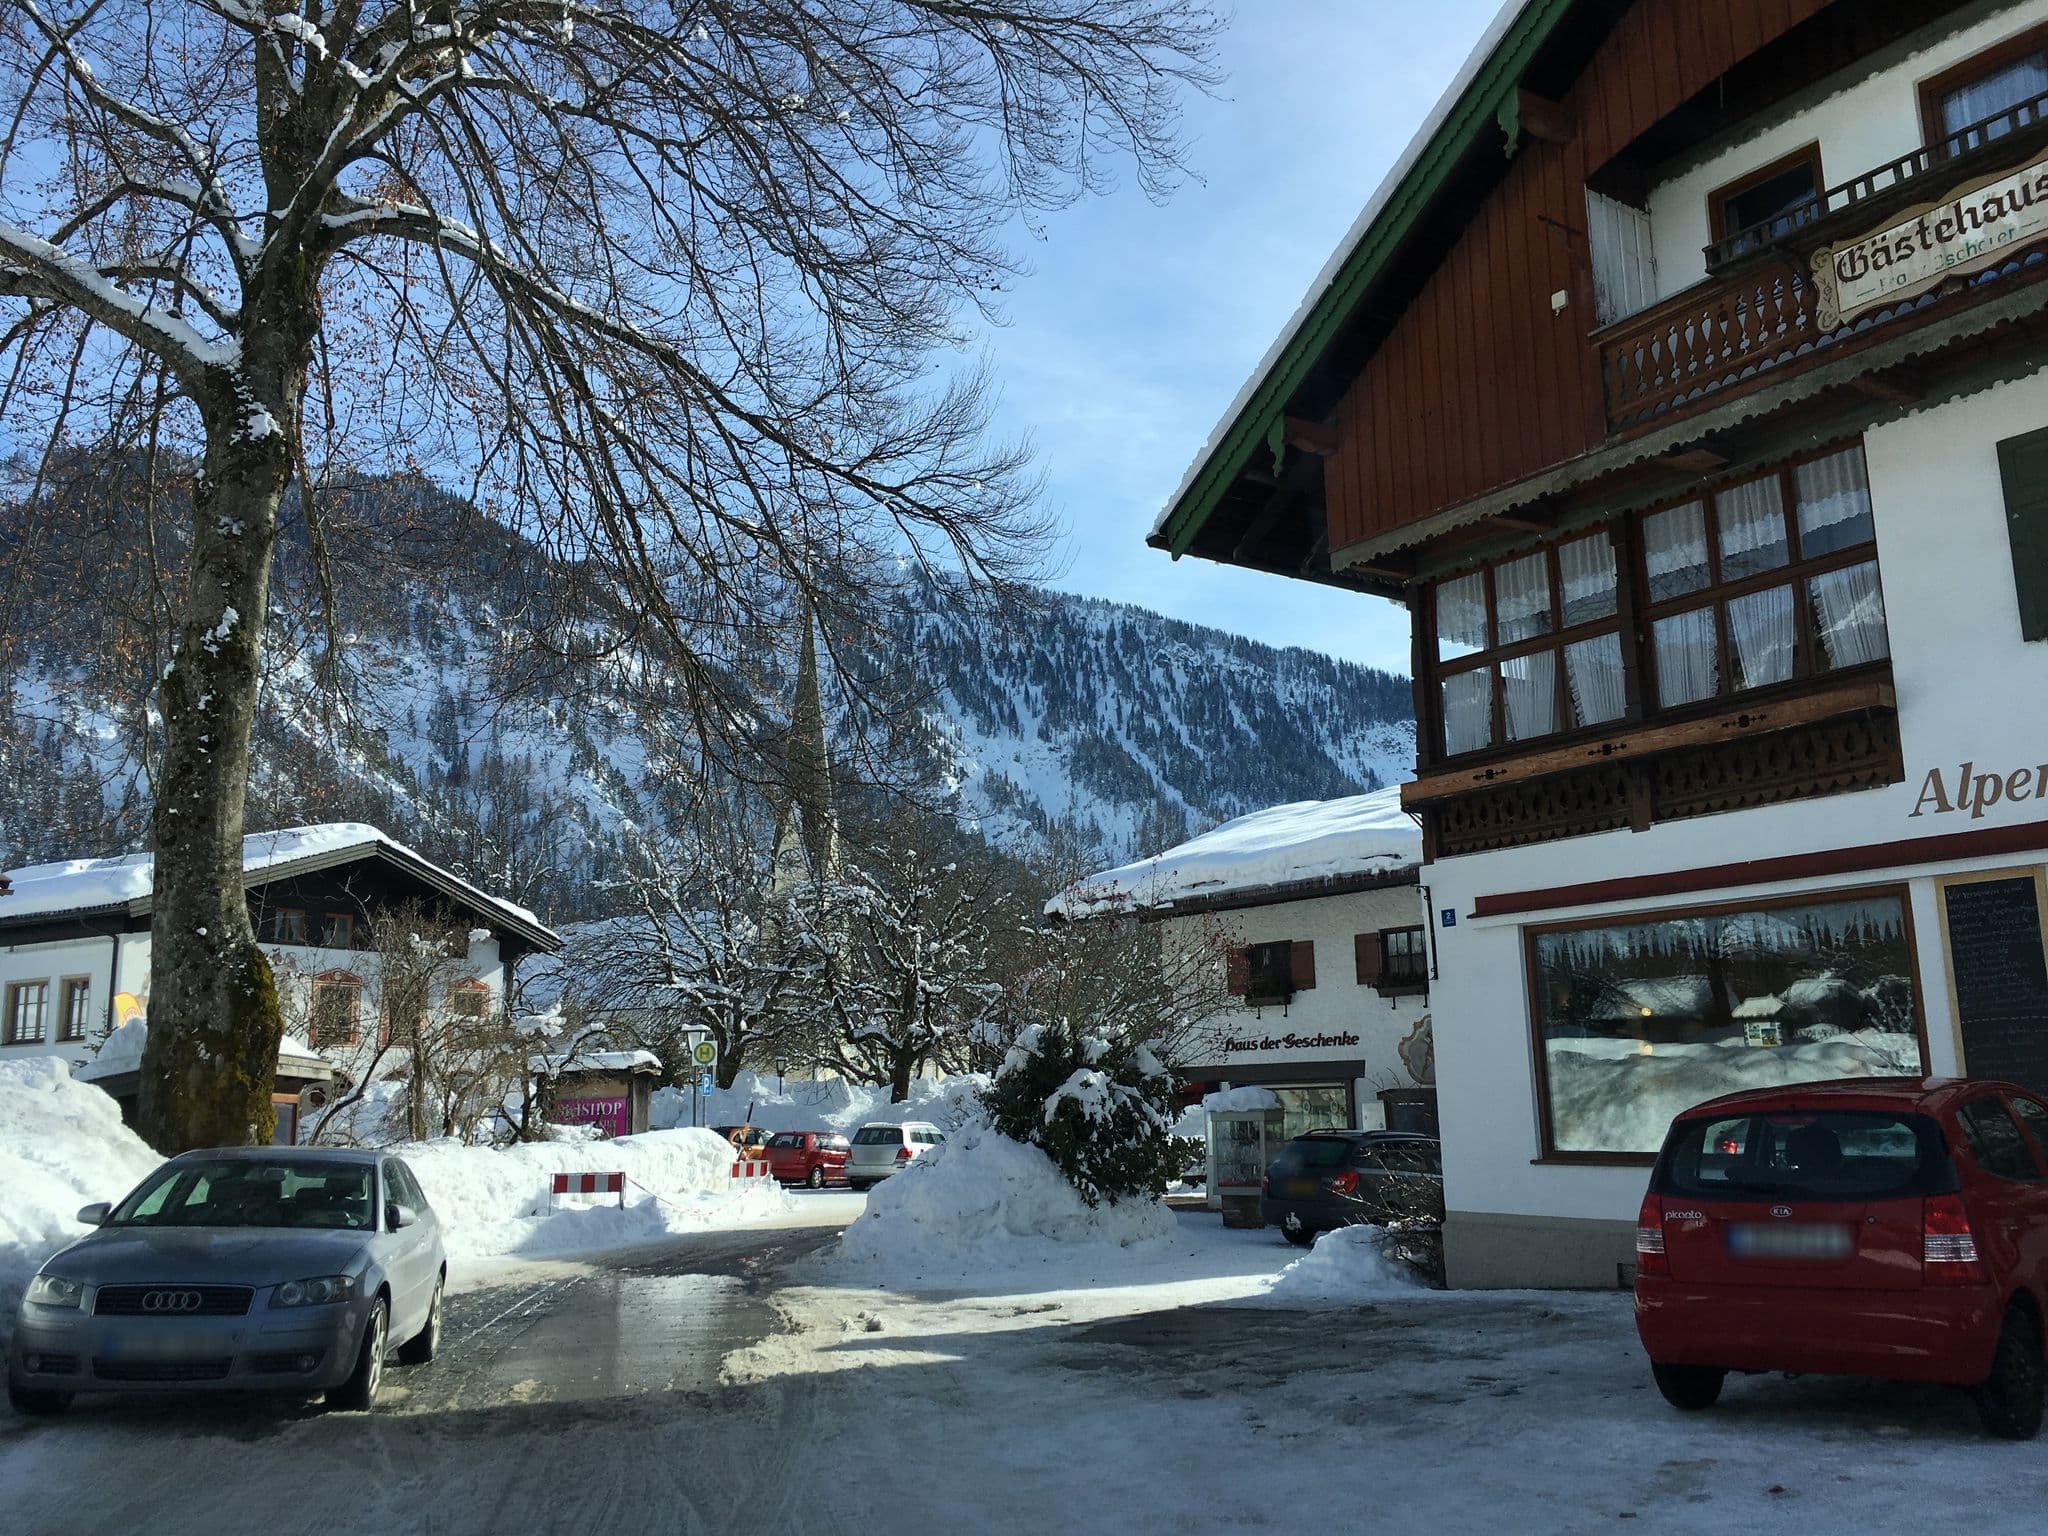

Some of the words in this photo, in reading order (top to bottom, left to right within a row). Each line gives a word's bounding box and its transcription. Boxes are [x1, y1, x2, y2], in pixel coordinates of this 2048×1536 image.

[1836, 174, 2048, 282] Gästehaus
[1260, 1036, 1282, 1050] der
[1282, 1031, 1360, 1049] Geschenke
[1665, 1210, 1702, 1221] picanto
[1772, 1206, 1790, 1216] KIA
